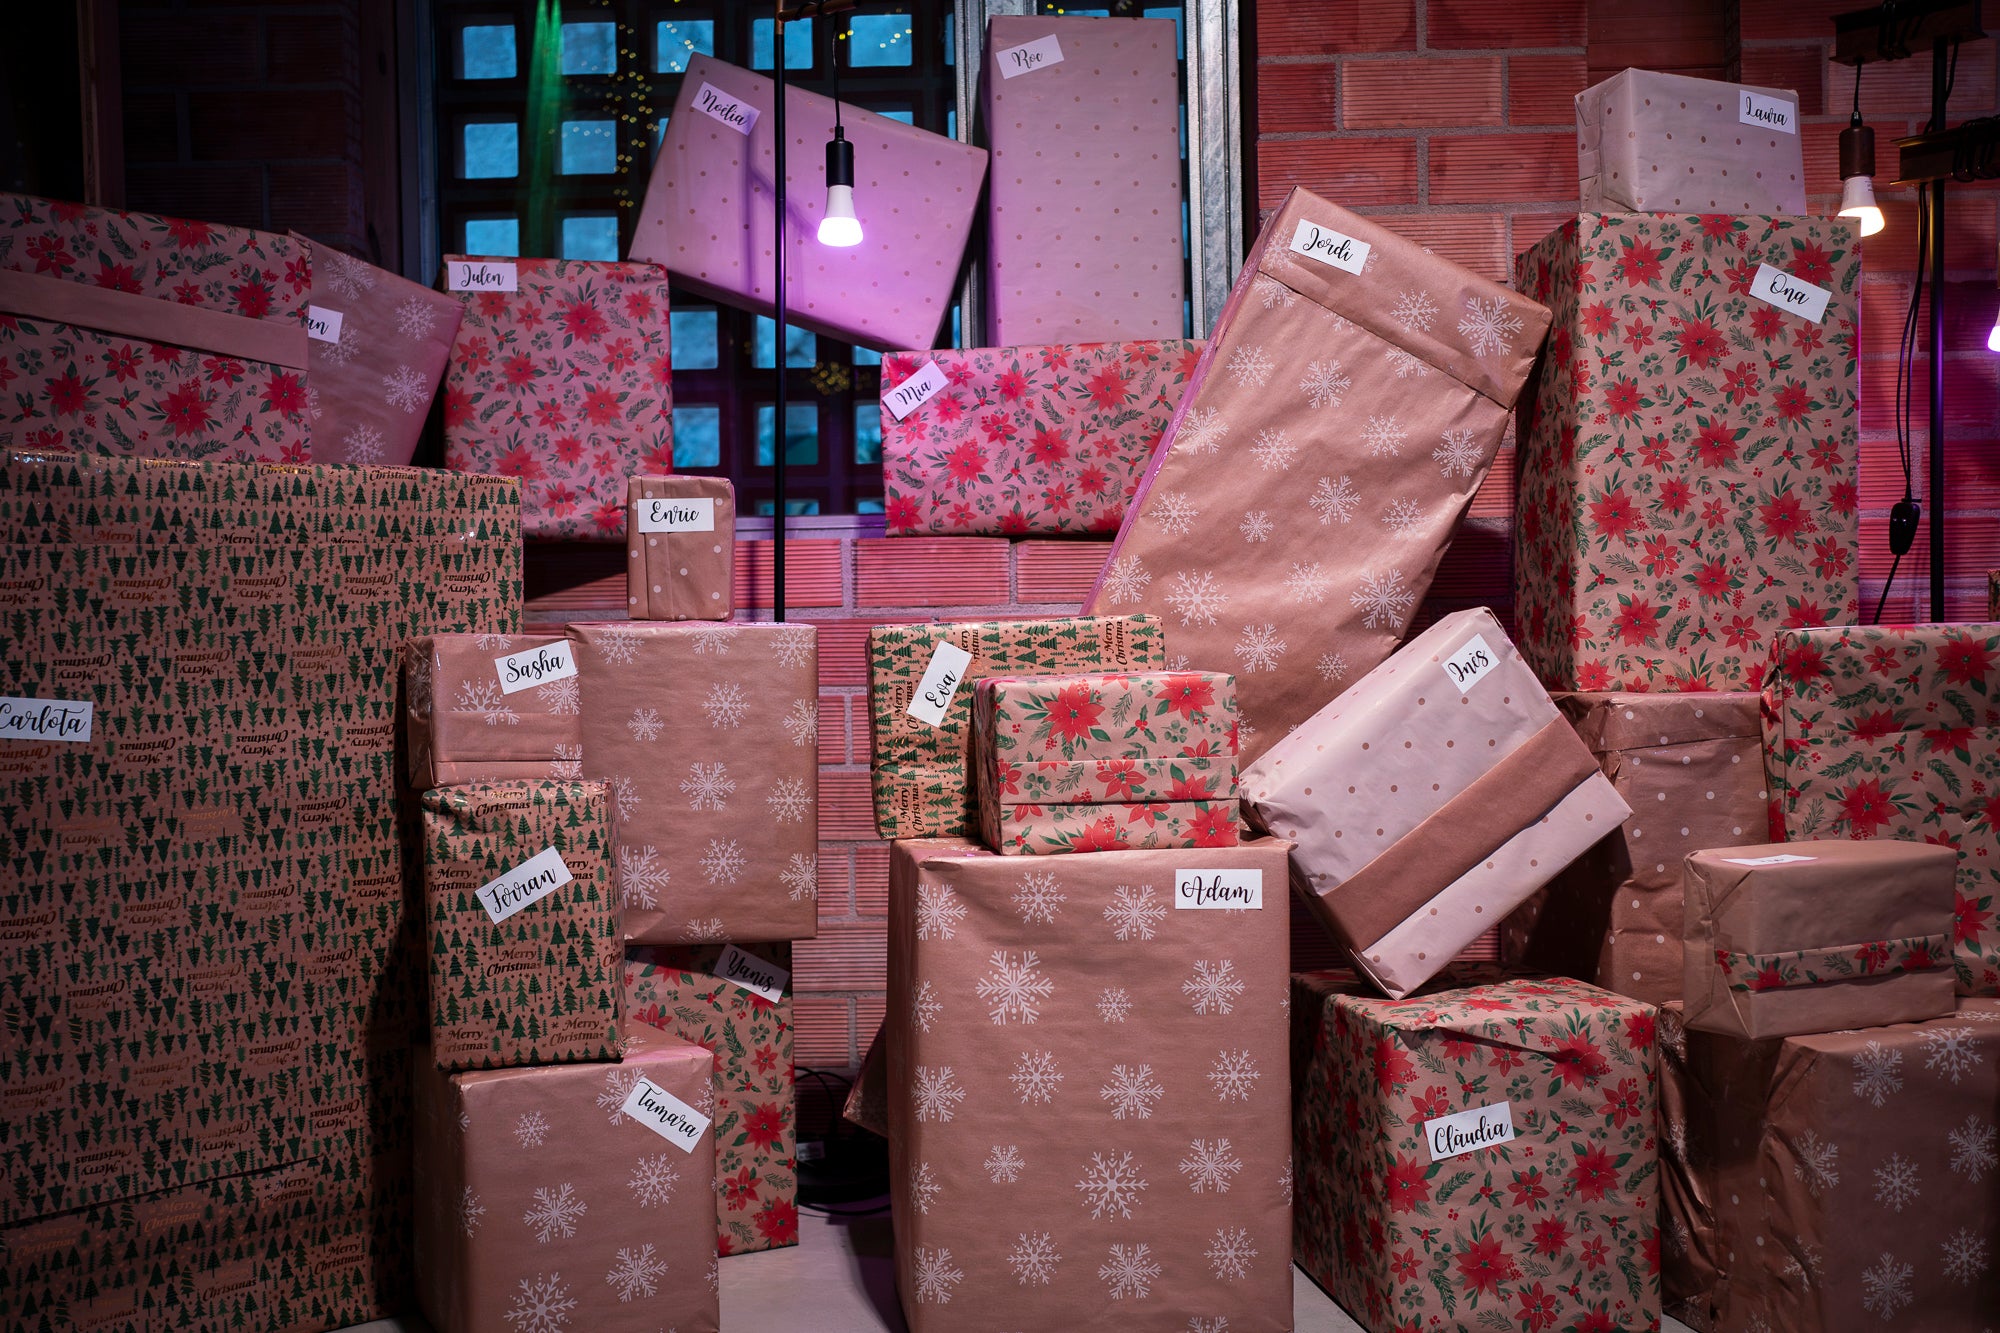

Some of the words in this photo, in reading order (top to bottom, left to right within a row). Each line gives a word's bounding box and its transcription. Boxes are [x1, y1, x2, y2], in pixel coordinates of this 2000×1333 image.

[1745, 96, 1788, 126] Laura
[1302, 227, 1354, 262] Jordi
[460, 263, 505, 287] Julen
[1769, 273, 1810, 305] Ona
[894, 380, 932, 405] Mia
[369, 470, 417, 482] Christmas
[650, 500, 700, 524] Enric
[96, 529, 134, 543] Merry
[218, 532, 256, 544] Merry
[113, 576, 172, 590] Christmas
[233, 574, 287, 588] Christmas
[345, 572, 394, 585] Christmas
[116, 590, 157, 602] Merry
[237, 588, 275, 600] Merry
[348, 586, 382, 599] Merry
[447, 584, 479, 596] Merry
[961, 629, 970, 652] erry
[1102, 620, 1114, 654] Merry
[1115, 619, 1128, 665] Christma
[52, 653, 112, 667] Christmas
[175, 649, 230, 663] Christmas
[178, 663, 217, 676] Merry
[506, 649, 565, 683] Sasha
[57, 668, 98, 683] Merry
[924, 670, 957, 708] Eva
[893, 685, 905, 718] Merry
[0, 702, 87, 736] Carlota
[236, 729, 289, 743] Christmas
[346, 722, 395, 736] Christmas
[119, 737, 176, 751] Christmas
[241, 744, 277, 756] Merry
[350, 736, 385, 749] Merry
[123, 752, 163, 765] Merry
[297, 796, 348, 812] Christmas
[475, 801, 531, 817] Christmas
[898, 787, 911, 820] Merry
[300, 811, 336, 825] Merry
[564, 859, 589, 871] erry
[434, 867, 473, 880] Merry
[242, 884, 295, 900] Christmas
[356, 887, 391, 900] Merry
[429, 880, 478, 892] hristmas
[484, 868, 556, 913] Ferran
[1181, 875, 1254, 905] Adam
[124, 896, 182, 913] Christmas
[0, 910, 57, 927] Christma
[128, 912, 168, 927] Merry
[500, 948, 537, 962] Merry
[486, 961, 542, 977] Christmas
[726, 950, 776, 992] Yanis
[67, 979, 125, 998] Christmas
[191, 979, 230, 993] Merry
[565, 1018, 600, 1032] Merry
[448, 1029, 483, 1041] Merry
[249, 1037, 302, 1056] Christmas
[310, 1099, 360, 1118] Christmas
[637, 1081, 700, 1138] Tamara
[314, 1115, 350, 1129] Merry
[1434, 1115, 1509, 1153] Clàudia
[81, 1161, 121, 1177] Merry
[275, 1177, 310, 1191] Merry
[328, 1242, 361, 1258] Merry
[315, 1253, 364, 1275] Christmas
